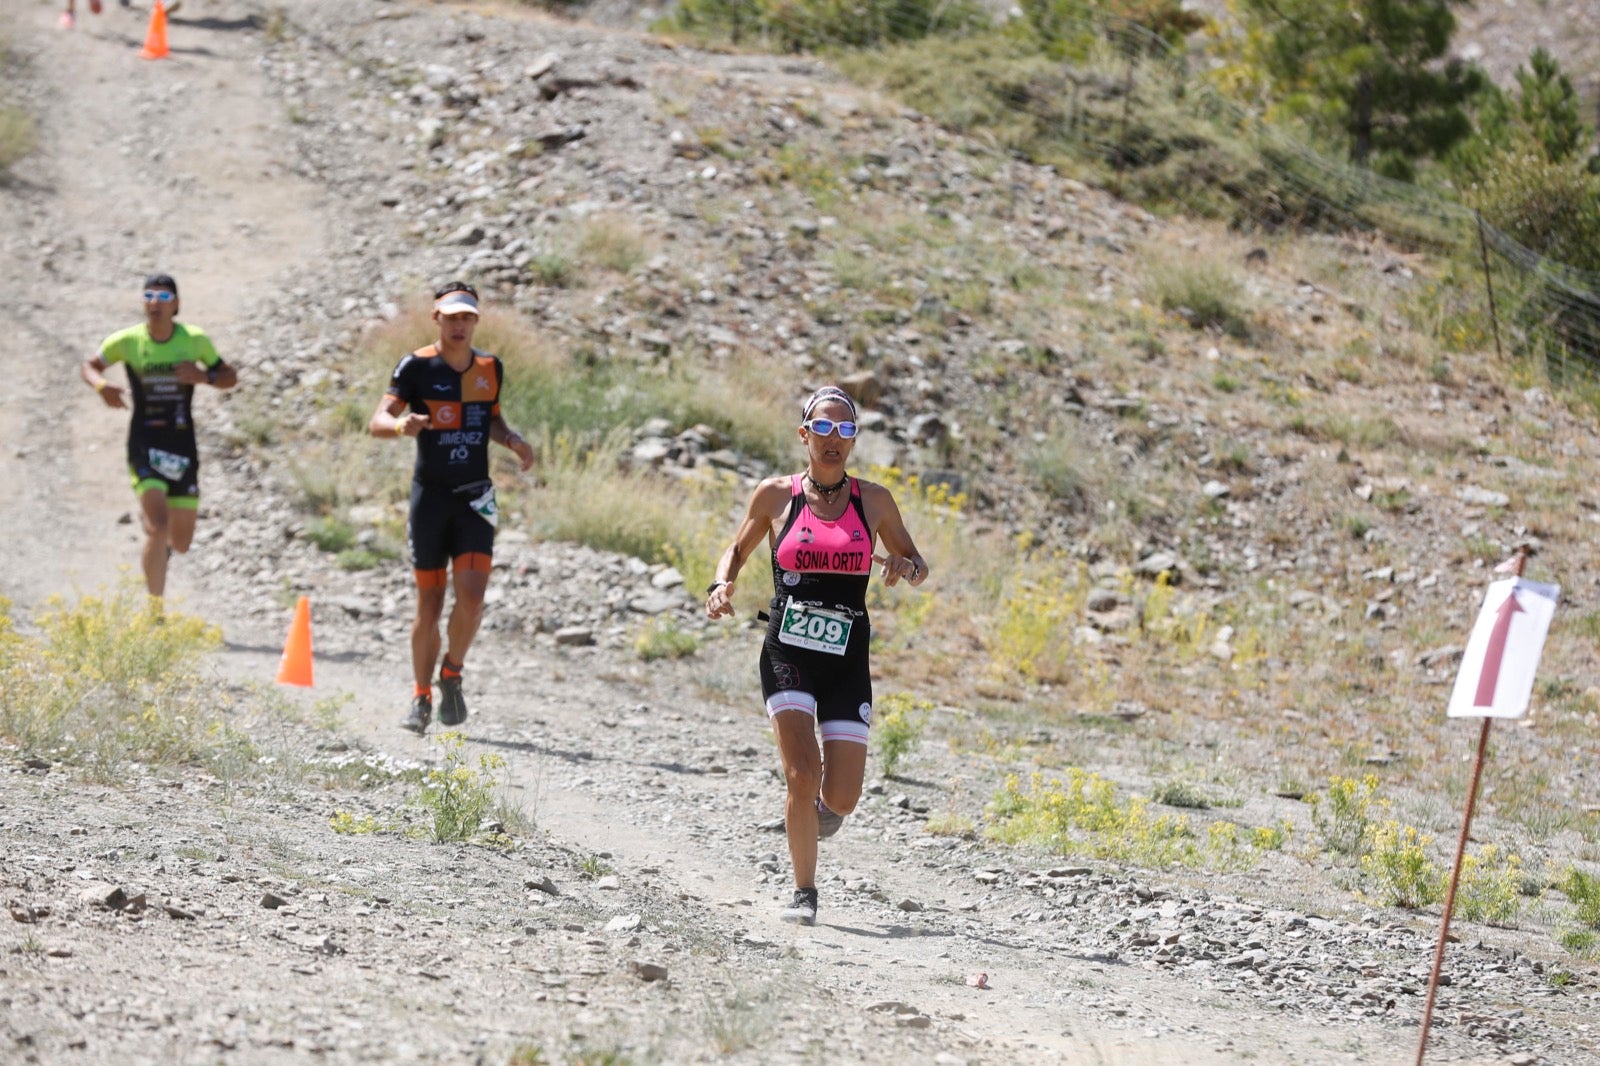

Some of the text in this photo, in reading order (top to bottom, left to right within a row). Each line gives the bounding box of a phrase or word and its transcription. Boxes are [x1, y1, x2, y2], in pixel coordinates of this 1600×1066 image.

[796, 550, 863, 571] SONIA ORTIZ
[789, 613, 842, 642] 209
